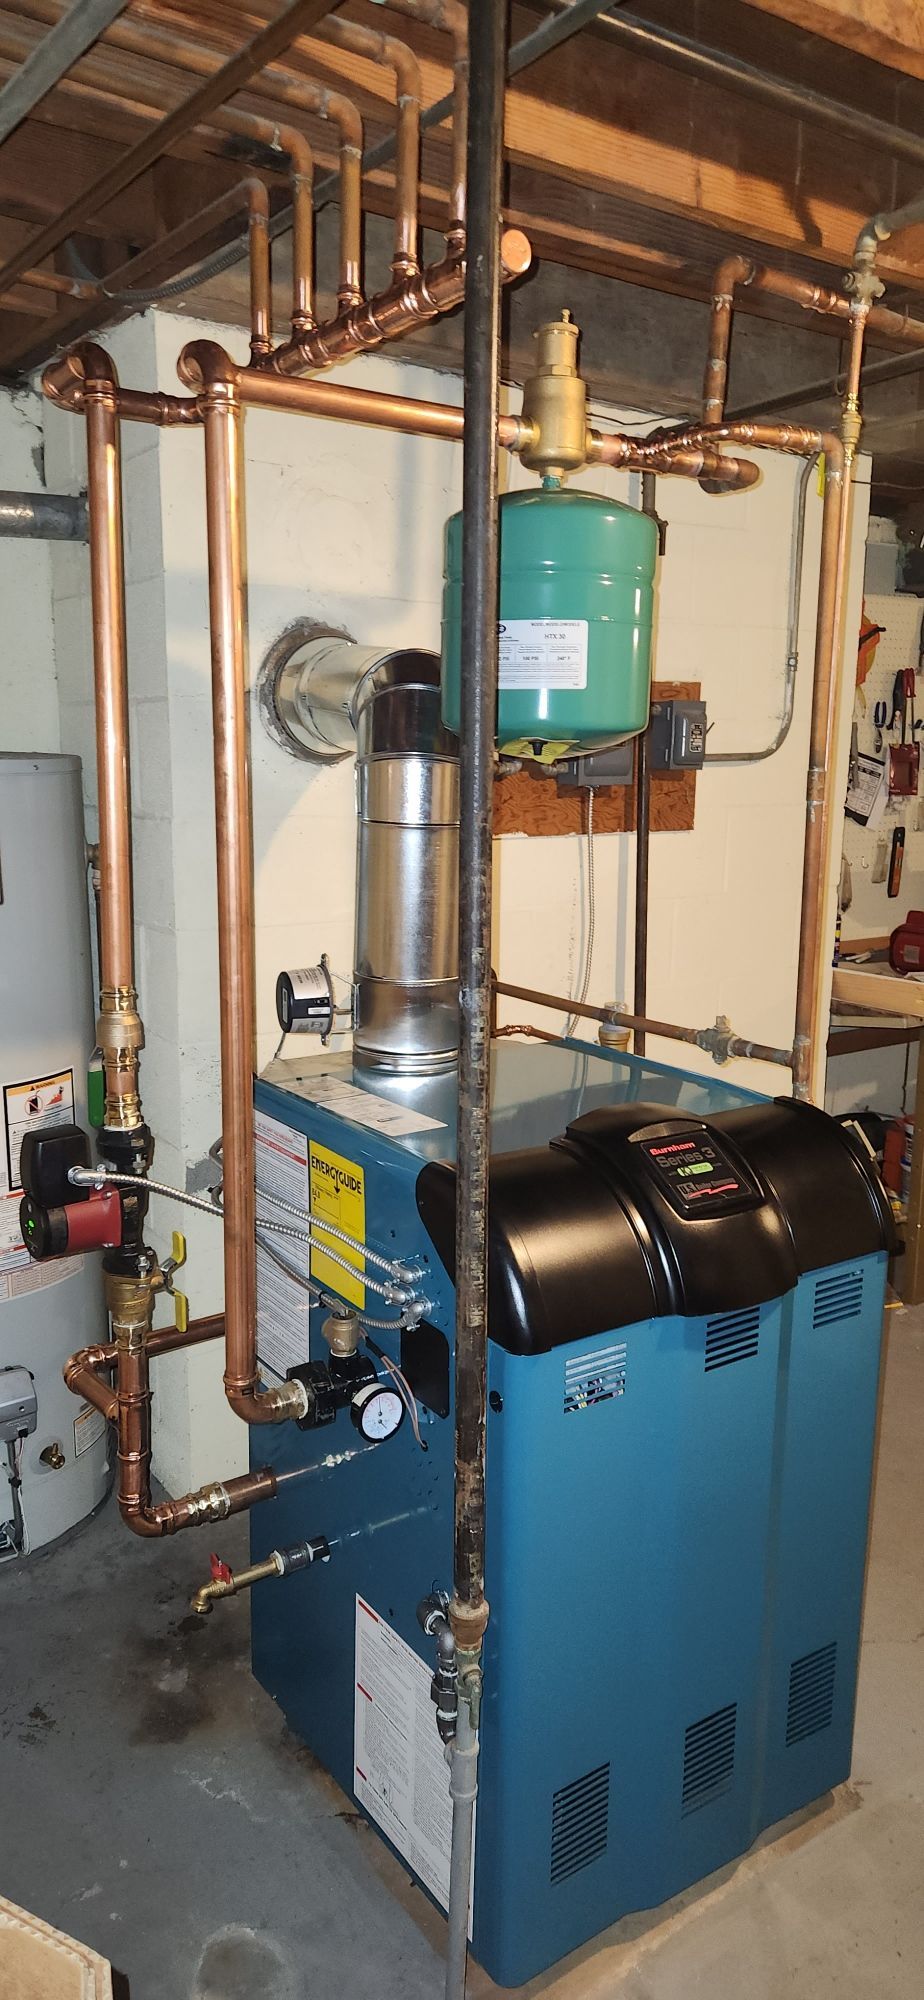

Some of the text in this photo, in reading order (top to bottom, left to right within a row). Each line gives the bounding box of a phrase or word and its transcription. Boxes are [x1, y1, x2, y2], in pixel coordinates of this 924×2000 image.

[649, 1142, 696, 1156] Burnham
[655, 1150, 704, 1168] Series
[701, 1146, 716, 1159] 3
[311, 1155, 362, 1195] ENERGYGUIDE
